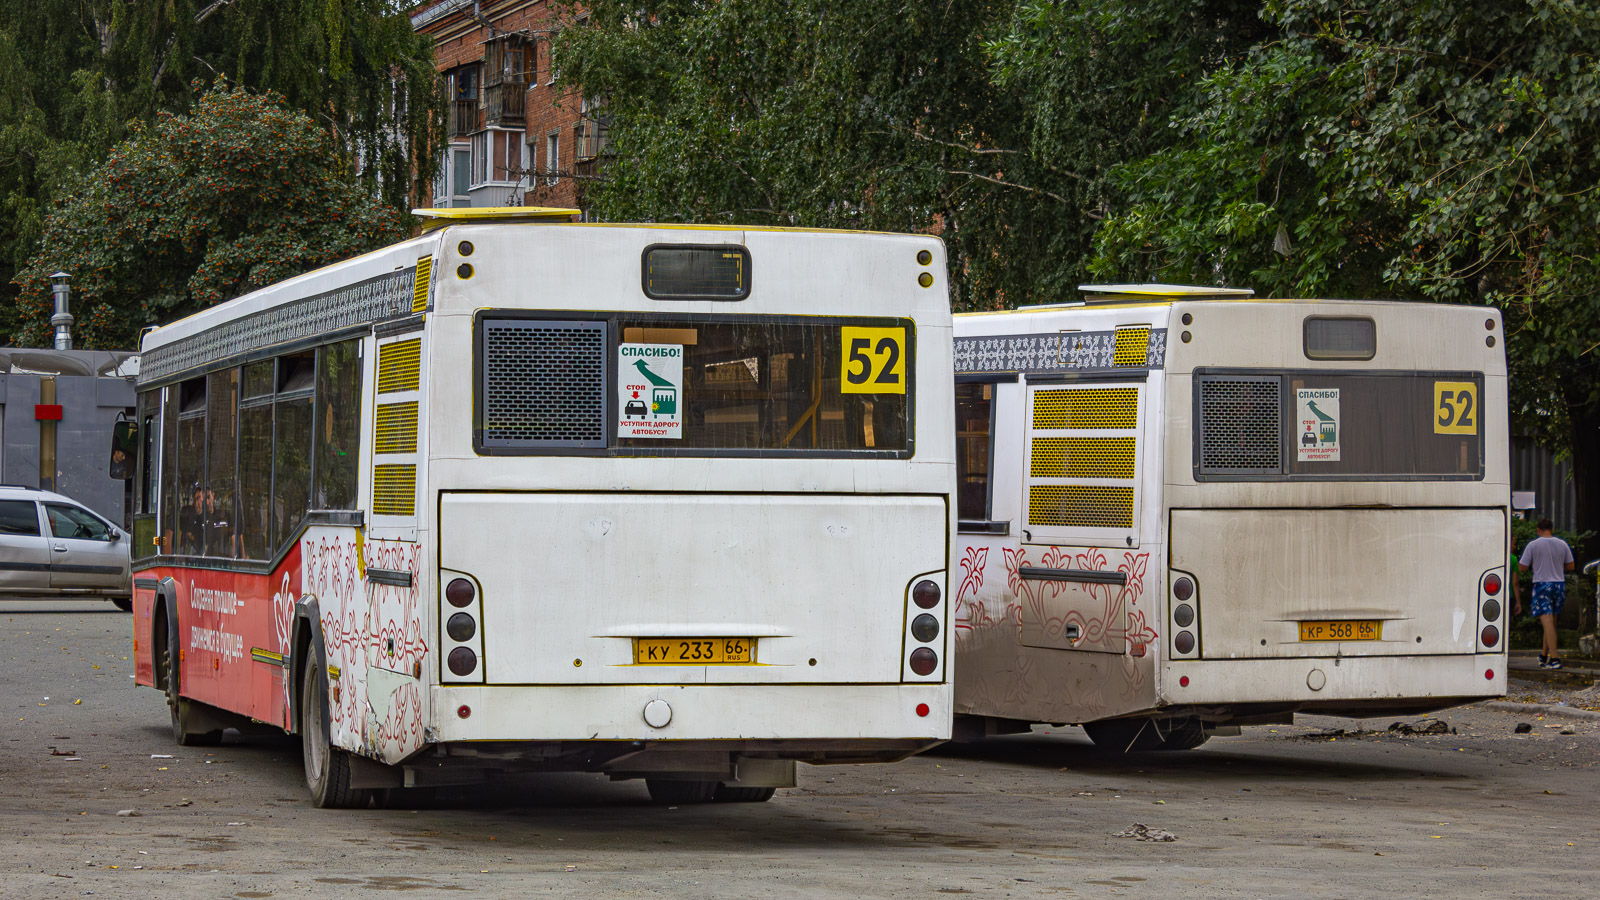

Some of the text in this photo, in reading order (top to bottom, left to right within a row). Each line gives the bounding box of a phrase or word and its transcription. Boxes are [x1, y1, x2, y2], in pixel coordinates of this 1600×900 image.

[621, 347, 681, 357] СПАСИБО!
[847, 337, 900, 385] 52
[1298, 391, 1338, 399] СПАСИБО!
[1438, 390, 1473, 427] 52
[1308, 623, 1352, 638] КР 568
[1359, 622, 1371, 633] 66
[648, 641, 714, 660] КУ 233
[725, 640, 743, 654] 66
